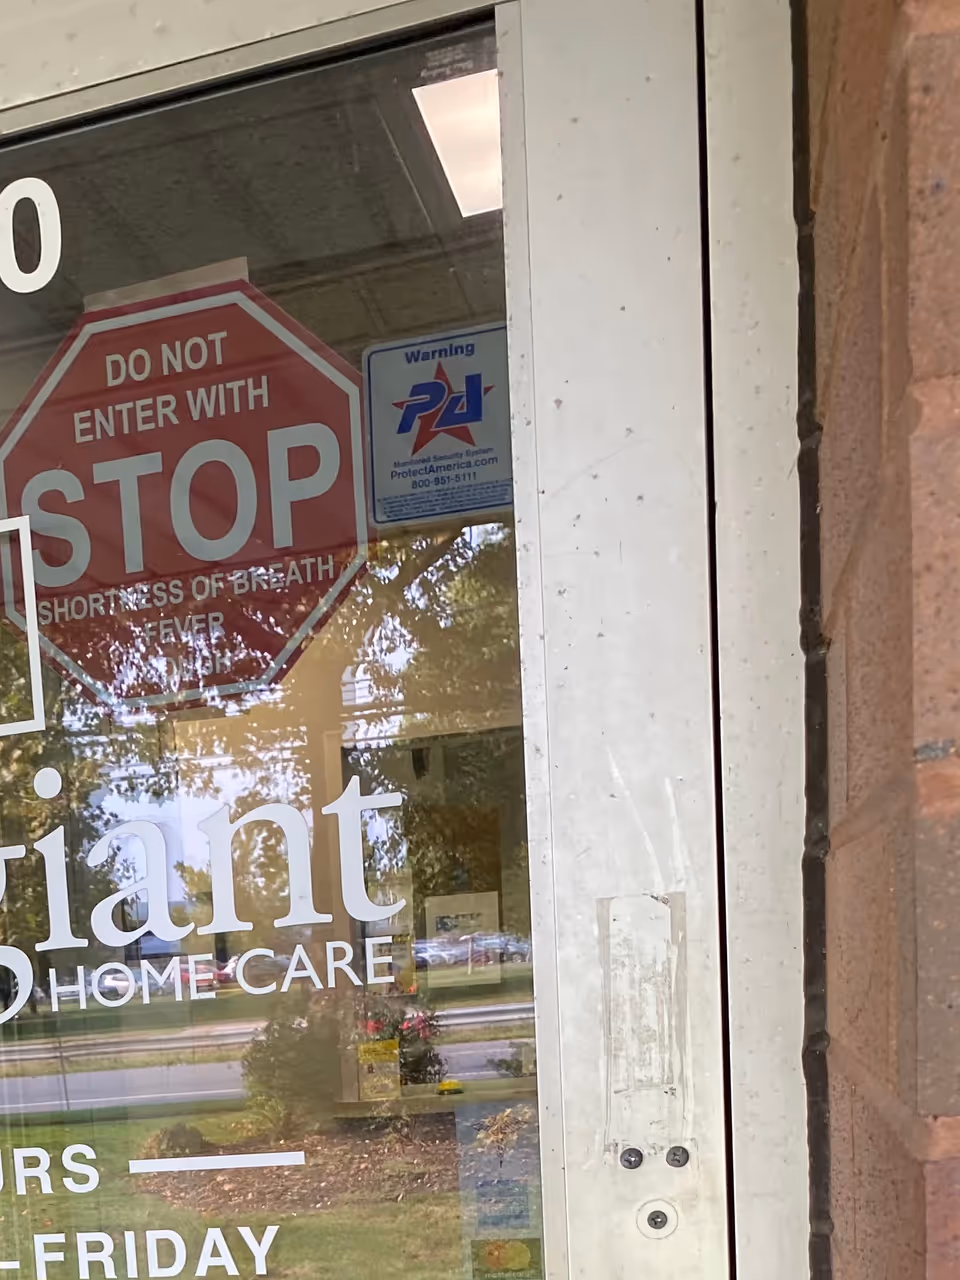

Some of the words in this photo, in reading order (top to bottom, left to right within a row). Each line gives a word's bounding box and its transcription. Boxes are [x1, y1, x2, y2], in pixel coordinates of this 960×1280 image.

[105, 348, 151, 387] DO
[161, 331, 227, 376] NOT
[405, 343, 475, 364] Warning
[73, 394, 179, 444] ENTER
[186, 375, 269, 421] WITH
[391, 457, 498, 480] ProtectAmerica.com
[412, 472, 477, 489] 800-951-5111
[21, 422, 340, 588] STOP
[39, 579, 184, 626] SHORTNESS
[191, 573, 226, 600] OF
[232, 554, 334, 595] BREATH
[145, 611, 225, 646] FEVER
[50, 954, 217, 1012] HOME
[237, 935, 397, 994] CARE
